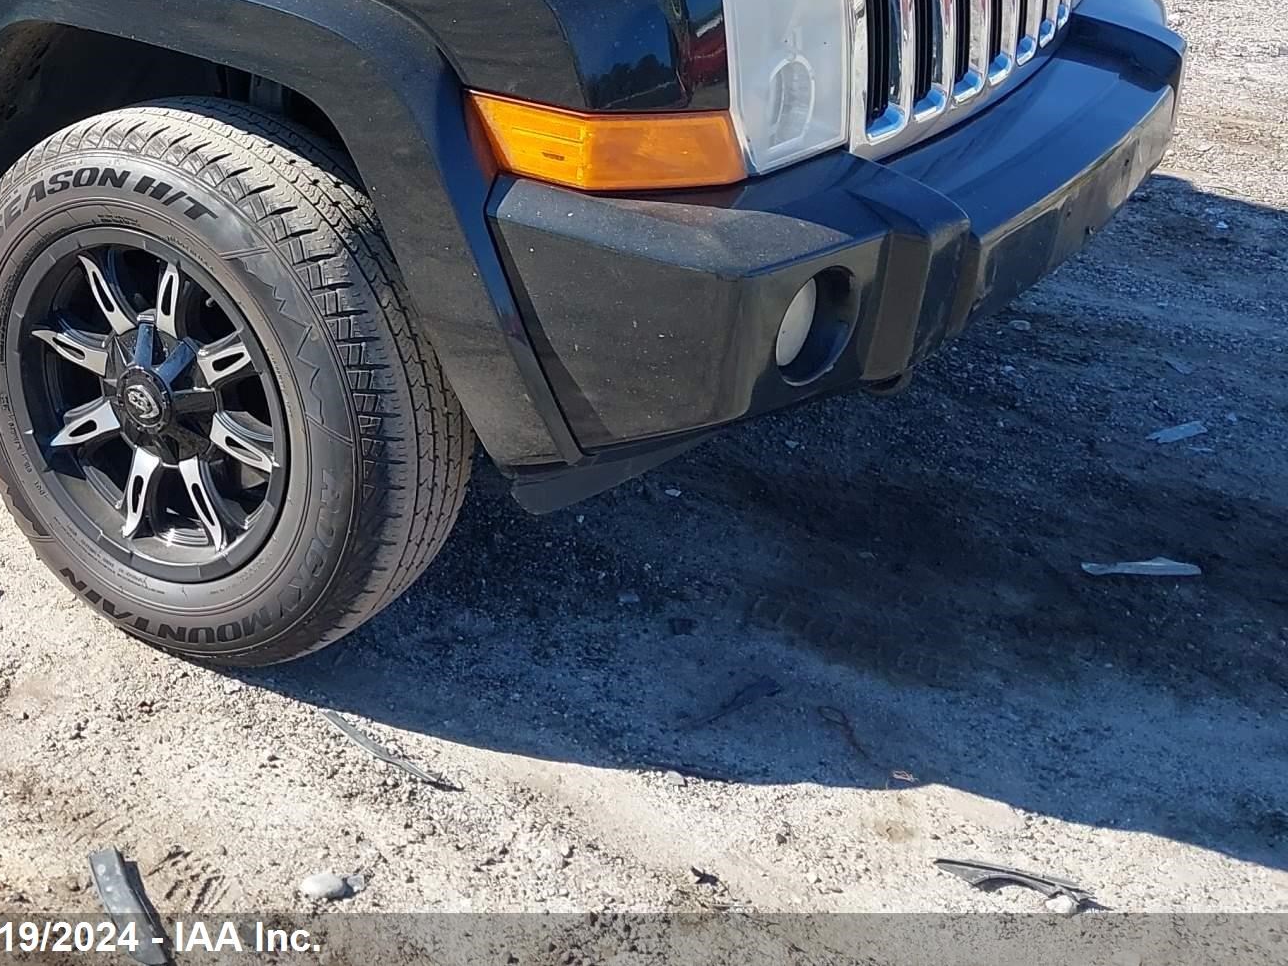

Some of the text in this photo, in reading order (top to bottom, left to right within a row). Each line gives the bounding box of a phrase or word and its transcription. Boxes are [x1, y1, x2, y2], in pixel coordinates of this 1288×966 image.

[133, 175, 219, 222] H/T
[273, 468, 344, 619] ROCKY
[58, 567, 276, 644] MOUNTAIN
